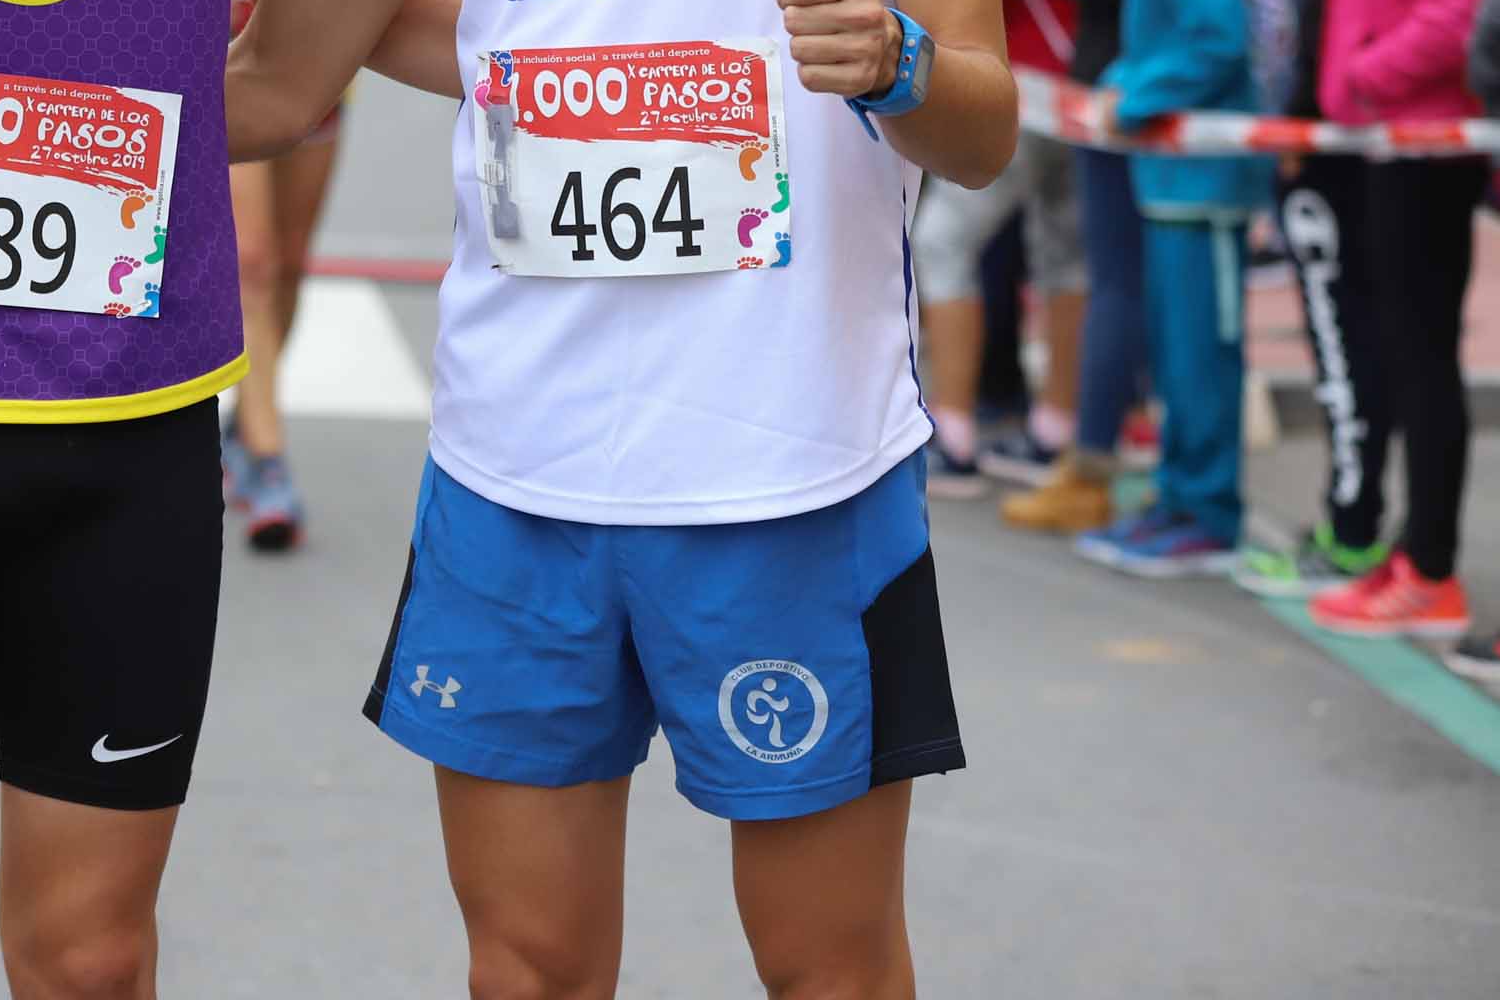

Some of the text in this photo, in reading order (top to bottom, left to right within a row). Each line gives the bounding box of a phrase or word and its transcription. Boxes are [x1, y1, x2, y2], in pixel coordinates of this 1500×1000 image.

[523, 53, 563, 64] inclusión
[566, 53, 596, 63] social
[612, 50, 645, 60] través
[649, 48, 665, 58] del
[668, 47, 710, 59] deporte
[701, 63, 716, 75] DE
[721, 62, 751, 76] LOS
[13, 83, 46, 94] través
[50, 87, 67, 97] del
[70, 89, 112, 102] deporte
[643, 78, 752, 108] PASOS
[101, 109, 115, 121] DE
[120, 111, 149, 127] LOS
[640, 105, 755, 125] 27 octubre 2019
[38, 117, 148, 155] PASOS
[30, 145, 145, 170] 27 octubre 2019
[551, 166, 705, 262] 464
[731, 662, 810, 681] CLUB DEPORTIVO
